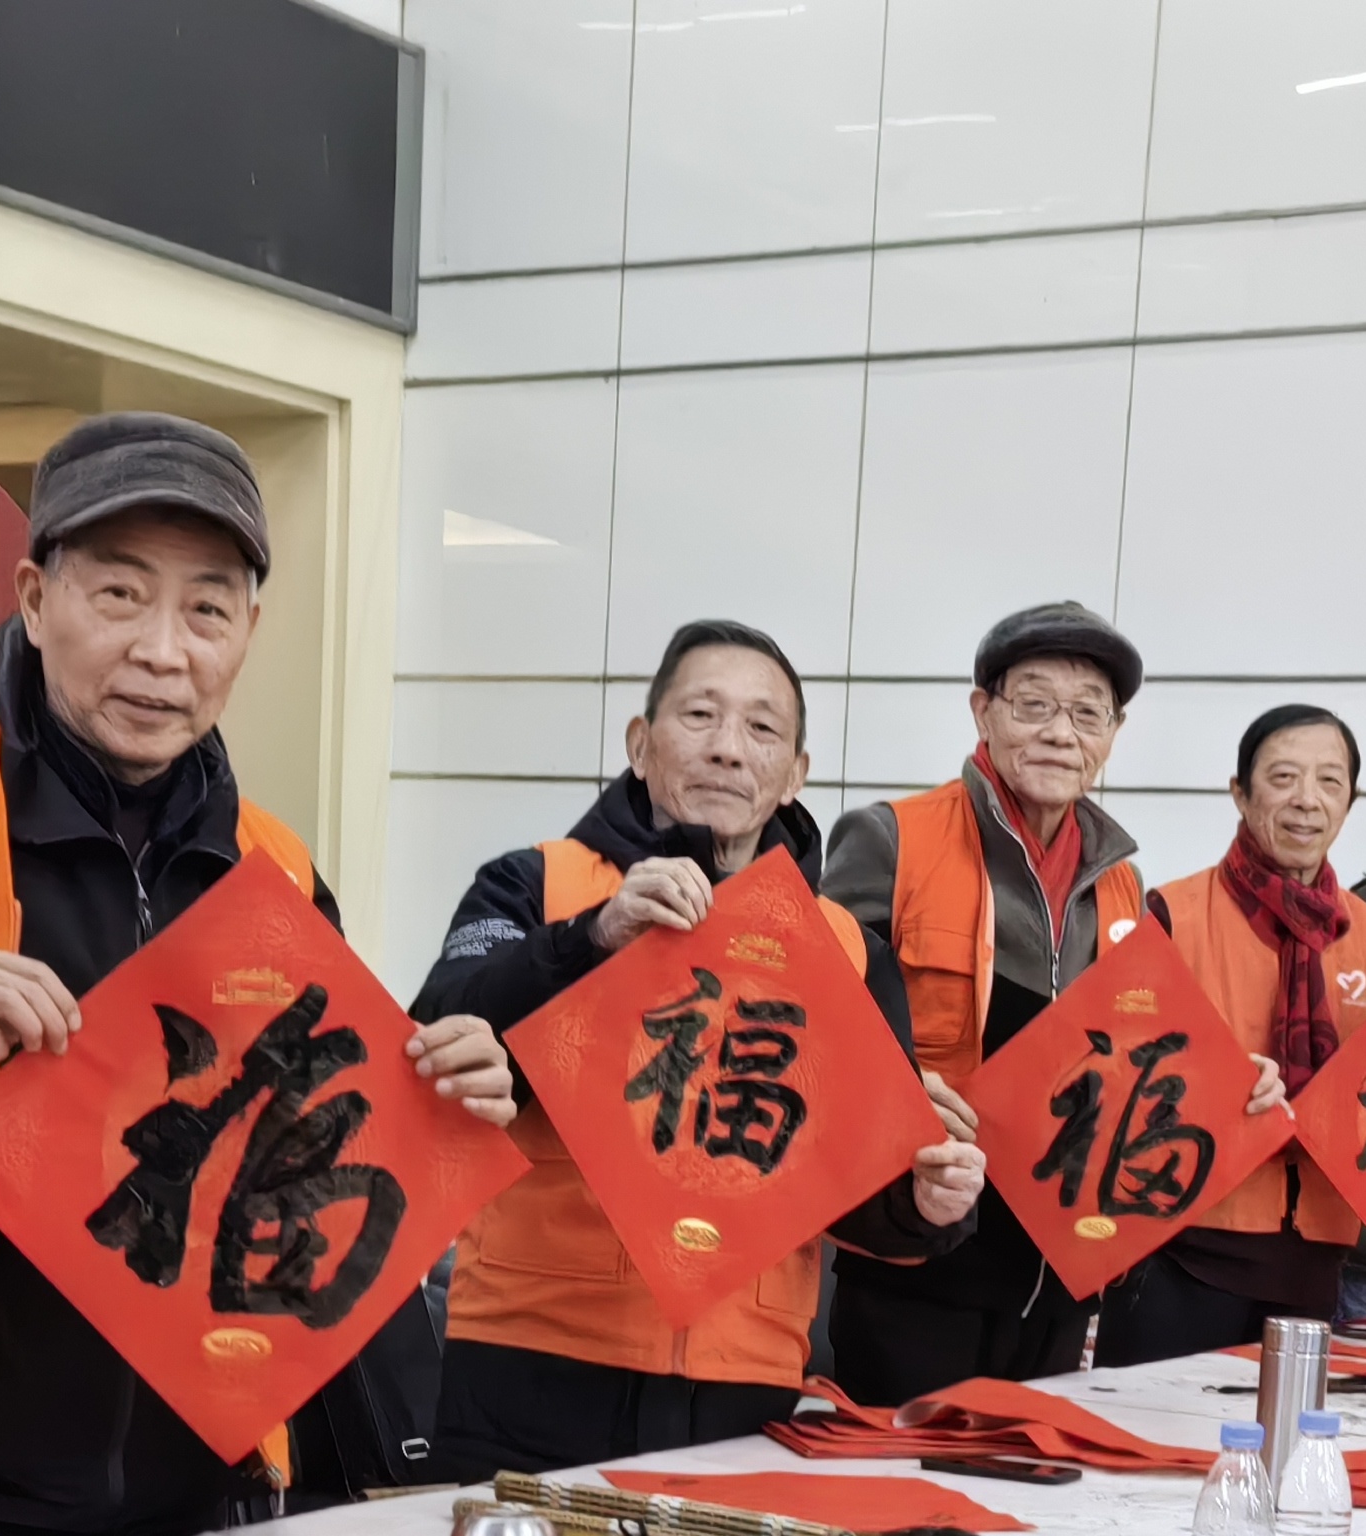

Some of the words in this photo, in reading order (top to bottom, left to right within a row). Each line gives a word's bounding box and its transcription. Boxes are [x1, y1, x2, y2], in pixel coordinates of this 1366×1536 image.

[84, 983, 408, 1328] 福
[622, 966, 808, 1176] 福
[1030, 1029, 1217, 1220] 福
